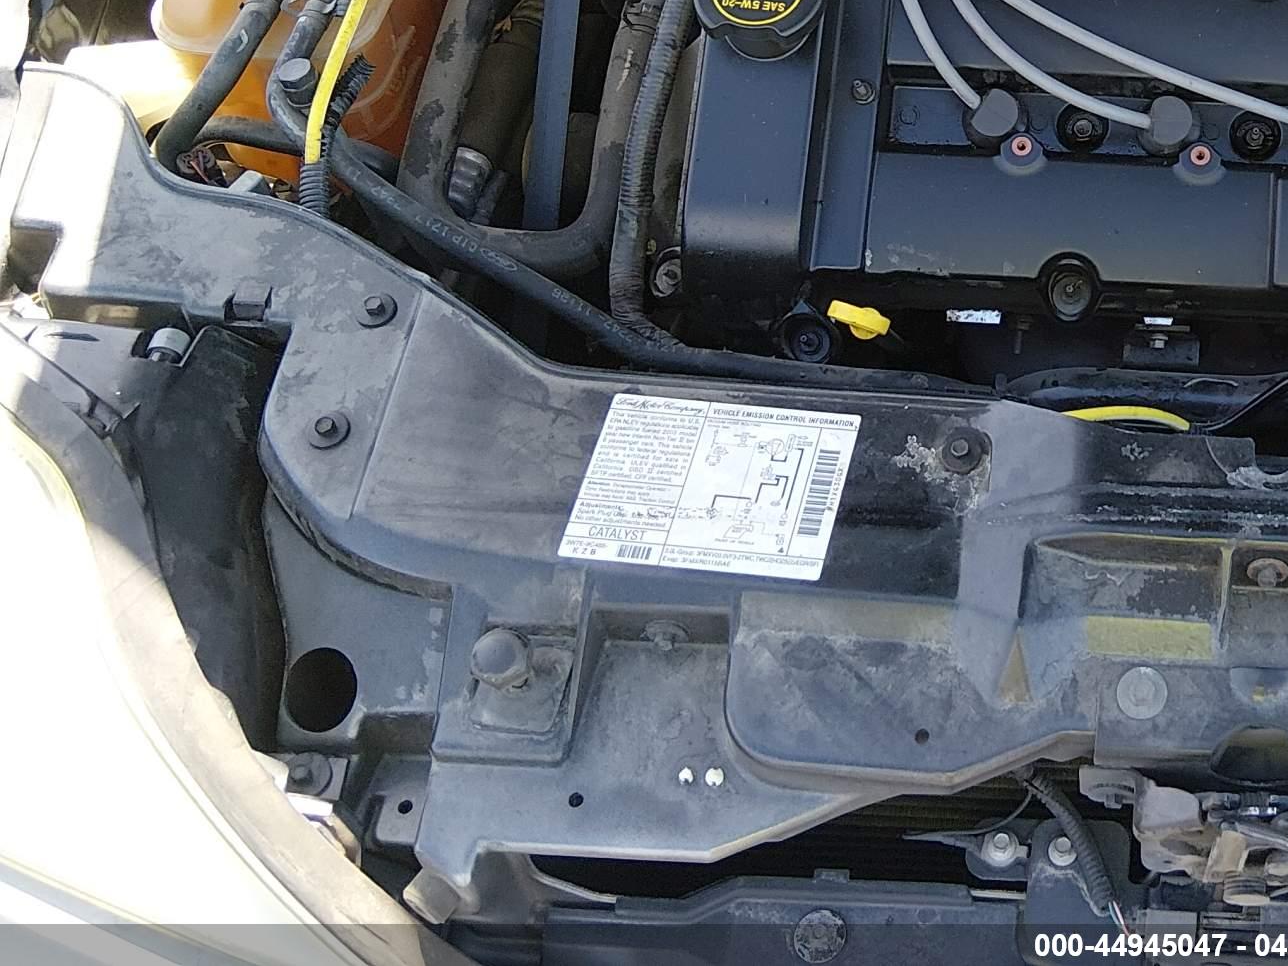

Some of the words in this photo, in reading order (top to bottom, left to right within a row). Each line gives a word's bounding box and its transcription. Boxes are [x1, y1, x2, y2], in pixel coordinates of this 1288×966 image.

[762, 1, 785, 11] SAE
[712, 408, 740, 416] VEHICLE
[741, 410, 774, 419] EMISSION
[775, 413, 806, 422] CONTROL
[808, 416, 854, 427] INFORMATION
[587, 525, 647, 541] CATALYST
